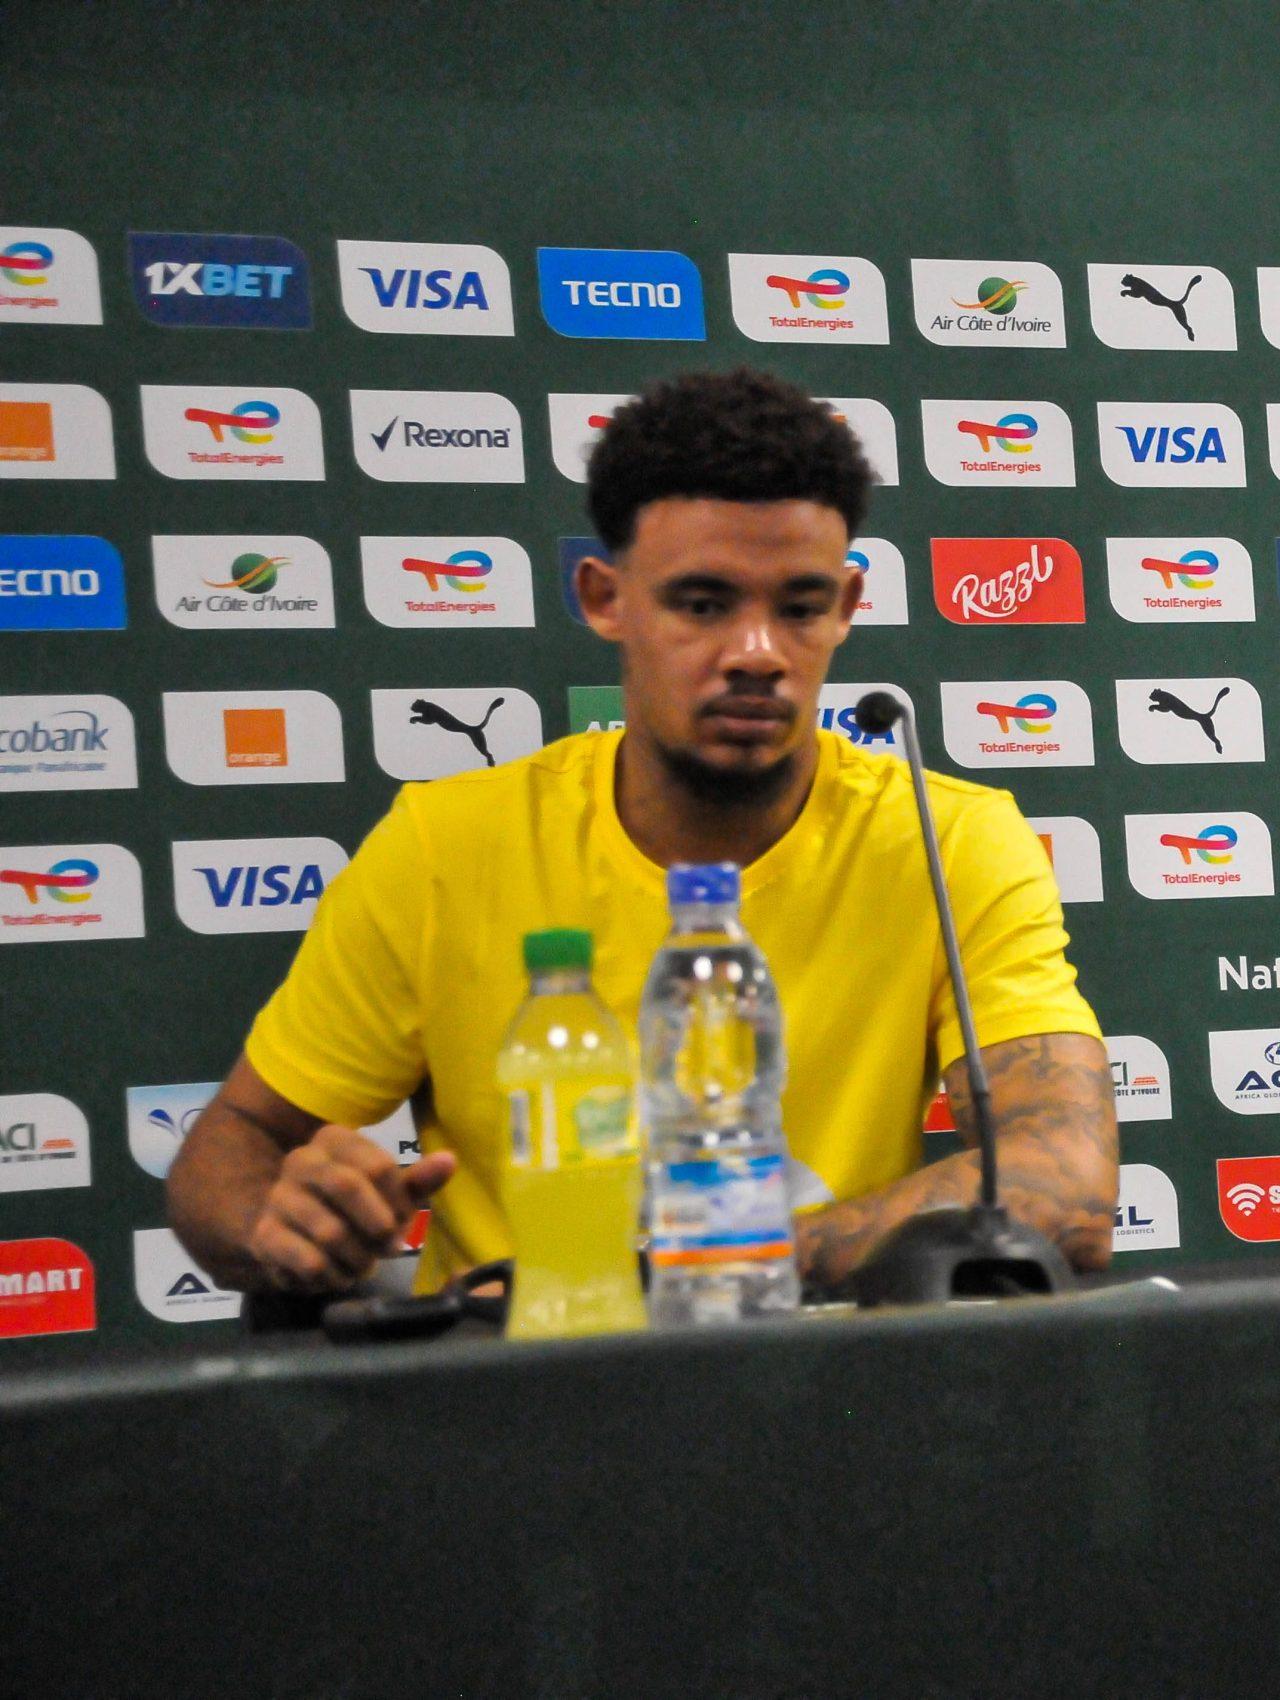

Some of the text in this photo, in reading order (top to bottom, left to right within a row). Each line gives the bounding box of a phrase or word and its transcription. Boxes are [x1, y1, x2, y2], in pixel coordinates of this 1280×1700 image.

[144, 262, 293, 298] 1XBET
[357, 268, 489, 311] VISA
[562, 280, 681, 308] TECNO
[768, 316, 854, 331] TotalEnergies
[930, 314, 1051, 332] Air Côte d'Ivoire
[404, 421, 508, 448] Rexona
[1114, 426, 1227, 464] VISA
[188, 452, 284, 466] TotalEnergies
[960, 461, 1041, 474] TotalEnergies
[0, 568, 100, 597] ECNO
[952, 544, 1053, 619] Razzl
[175, 595, 318, 613] Air Côte d'Ivoire
[405, 601, 496, 615] TotalEnergies
[1143, 597, 1222, 610] TotalEnergies
[0, 710, 109, 751] cobank
[979, 741, 1061, 754] TotalEnergies
[192, 864, 325, 907] VISA
[1162, 872, 1241, 885] TotalEnergies
[0, 1268, 83, 1296] MART
